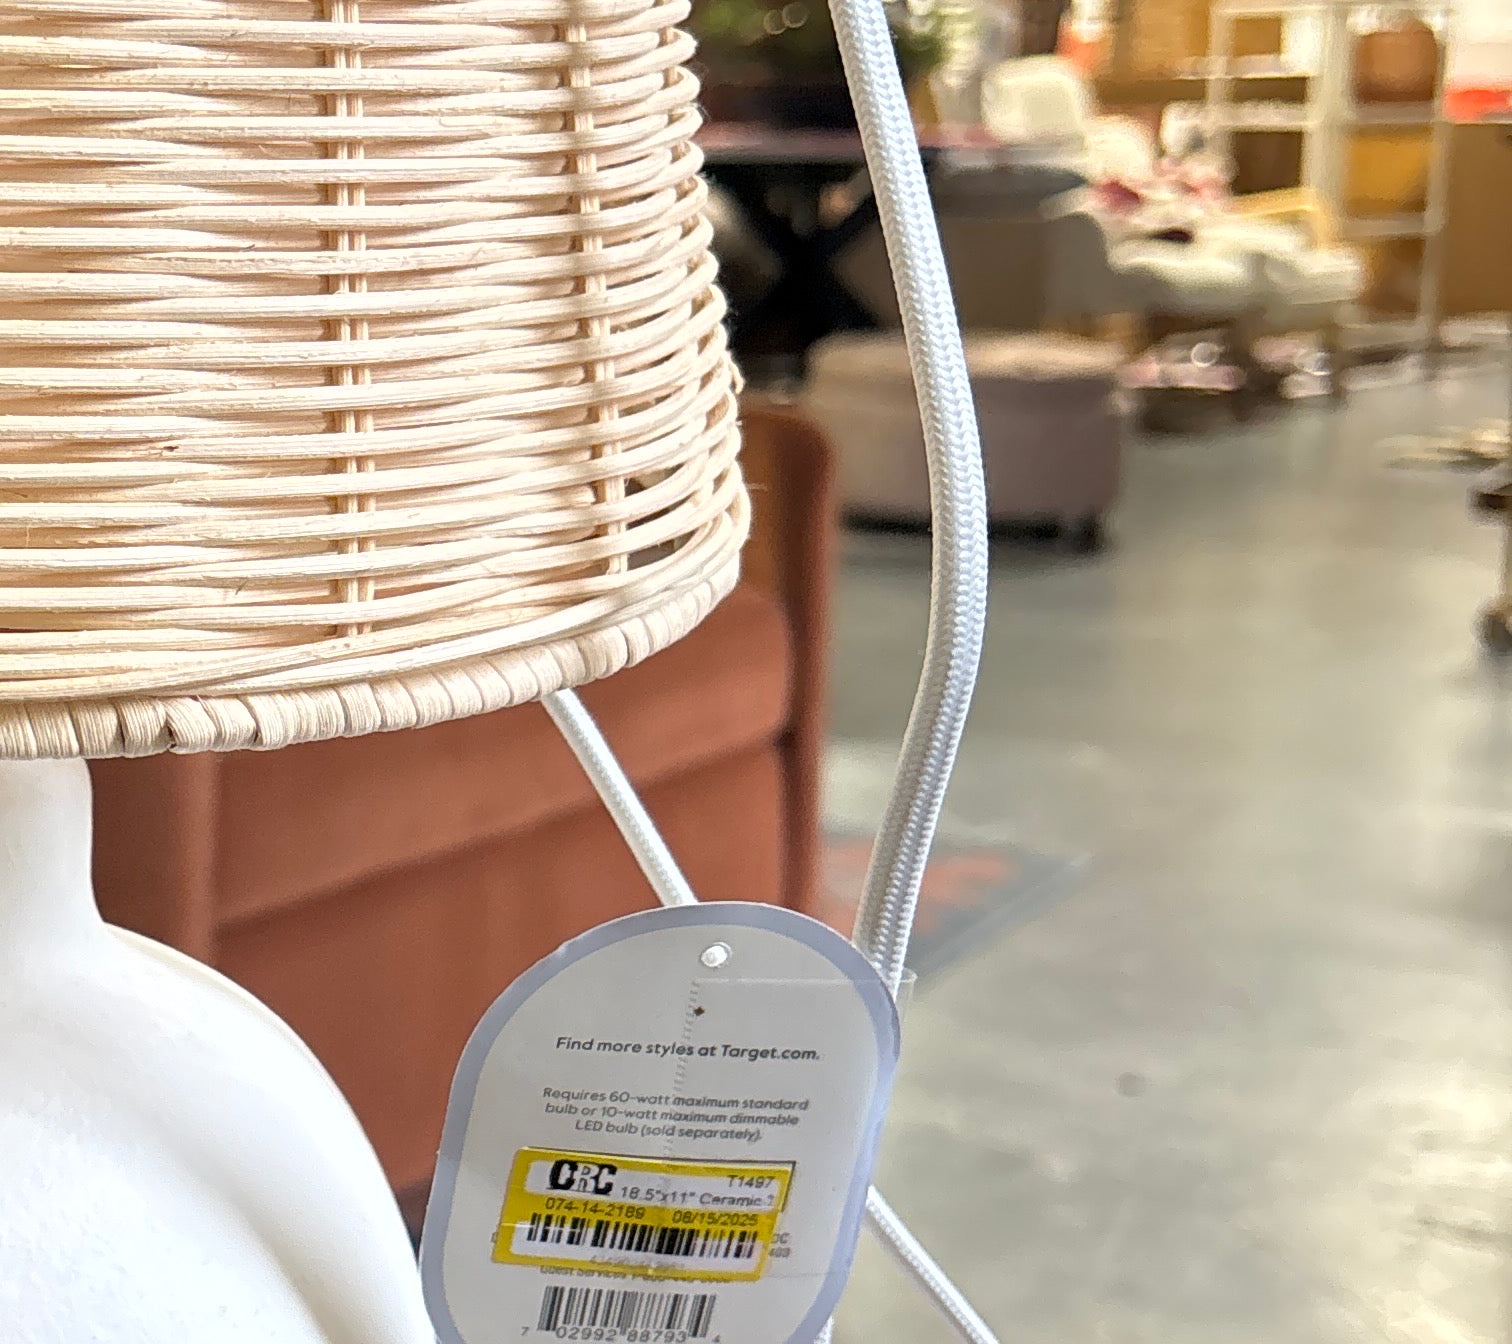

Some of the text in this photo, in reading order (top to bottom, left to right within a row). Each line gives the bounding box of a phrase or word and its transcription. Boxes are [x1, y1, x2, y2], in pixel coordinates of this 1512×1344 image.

[556, 1036, 820, 1062] Find more styles at Target.com.
[543, 1087, 809, 1111] Requires 60-watt maximum standard
[545, 1102, 799, 1126] bulb or 10-watt maximum dimmable
[575, 1119, 603, 1133] LED
[606, 1122, 639, 1135] bulb
[641, 1123, 675, 1138] (sold
[728, 1174, 776, 1189] T1497
[545, 1196, 647, 1220] 074-14-2189
[699, 1192, 762, 1207] Ceramic
[556, 1326, 617, 1342] 02992
[627, 1329, 687, 1344] 88793
